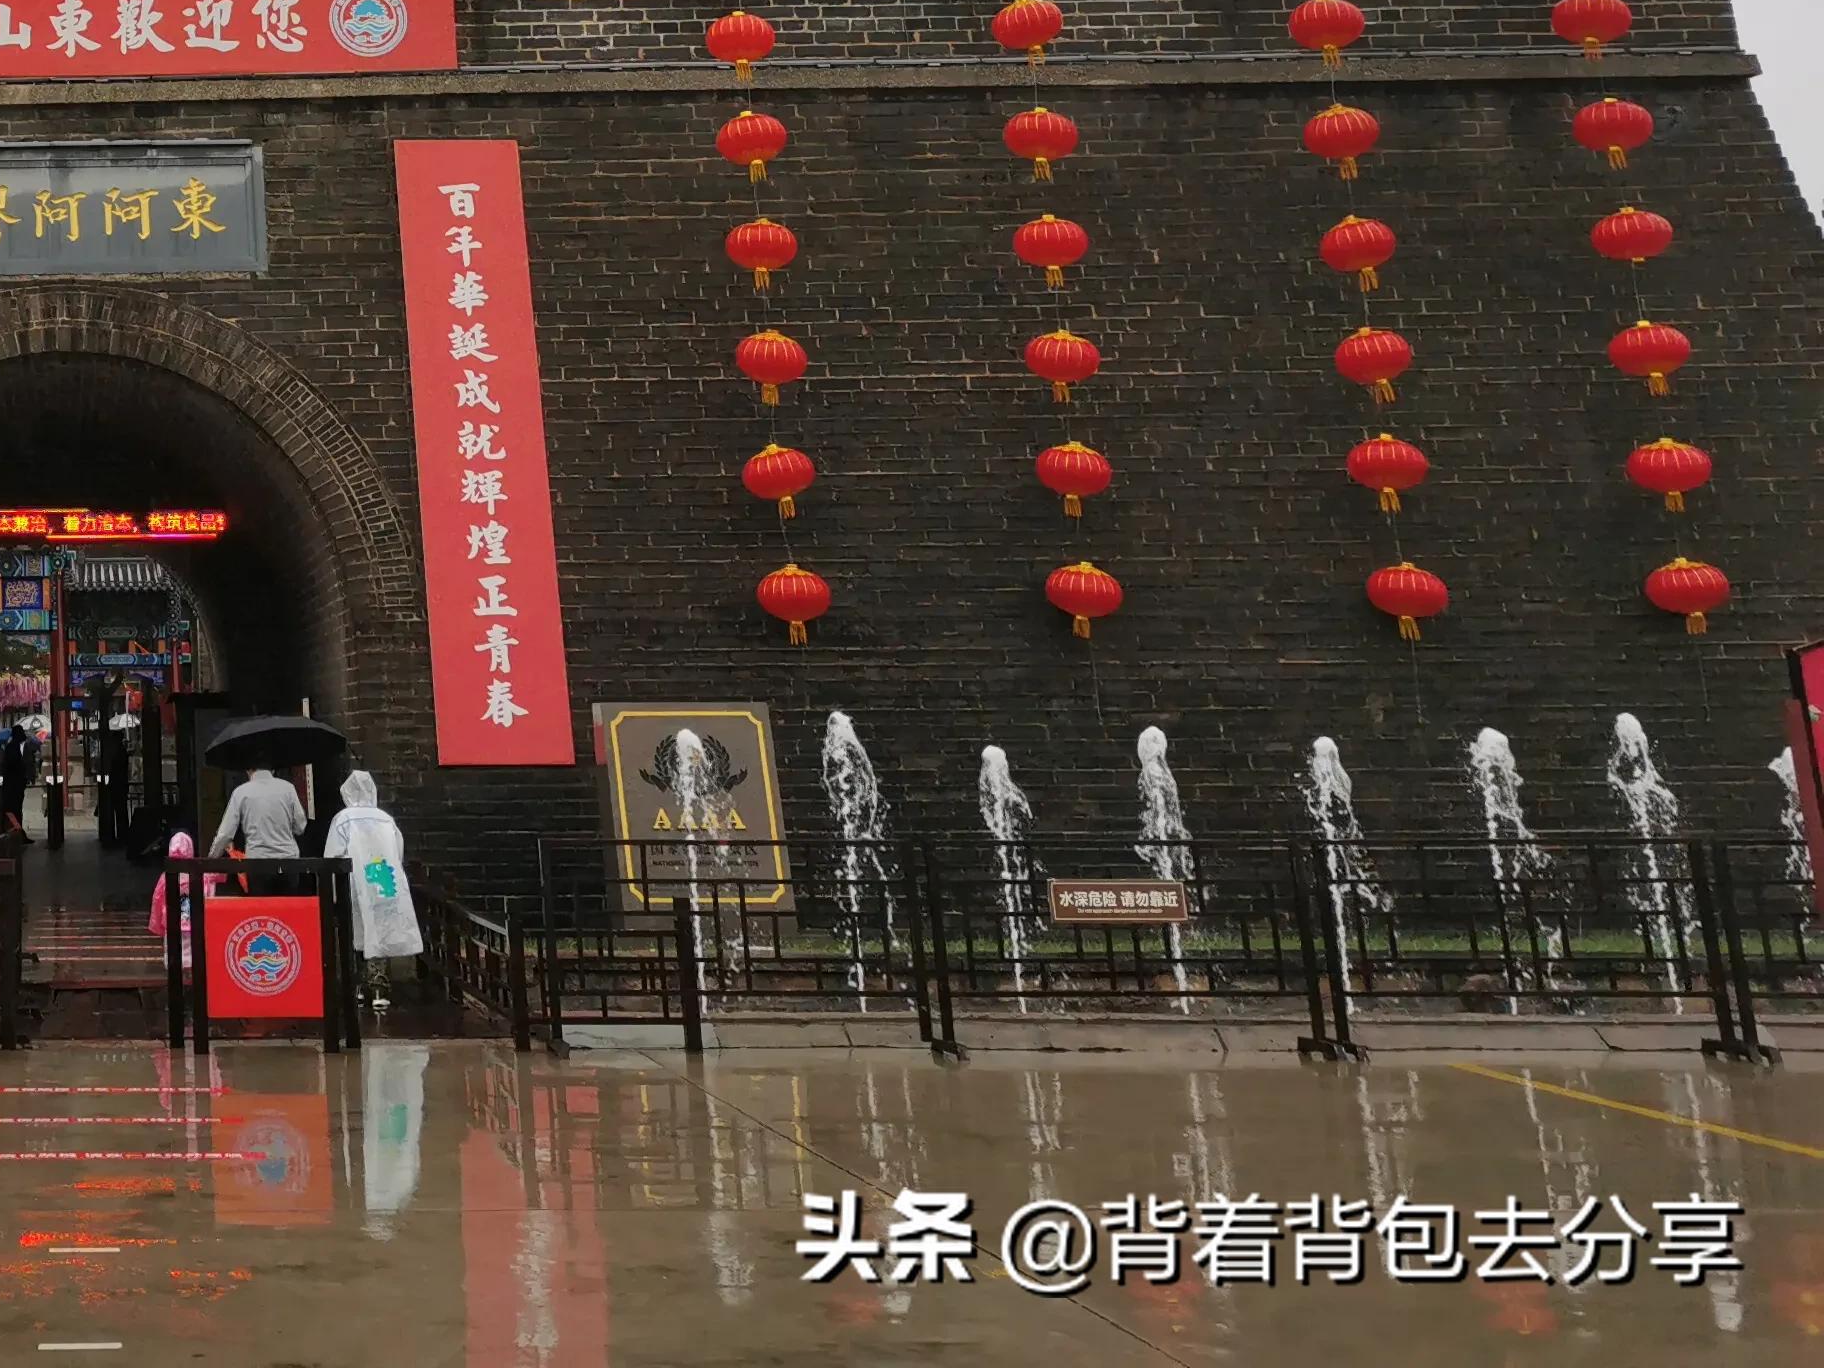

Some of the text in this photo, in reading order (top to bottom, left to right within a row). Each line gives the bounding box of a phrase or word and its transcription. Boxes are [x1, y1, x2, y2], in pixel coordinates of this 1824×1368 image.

[437, 182, 529, 728] 百年華誕成就輝煌正青春
[1059, 891, 1179, 907] 水深危险 请勿靠近
